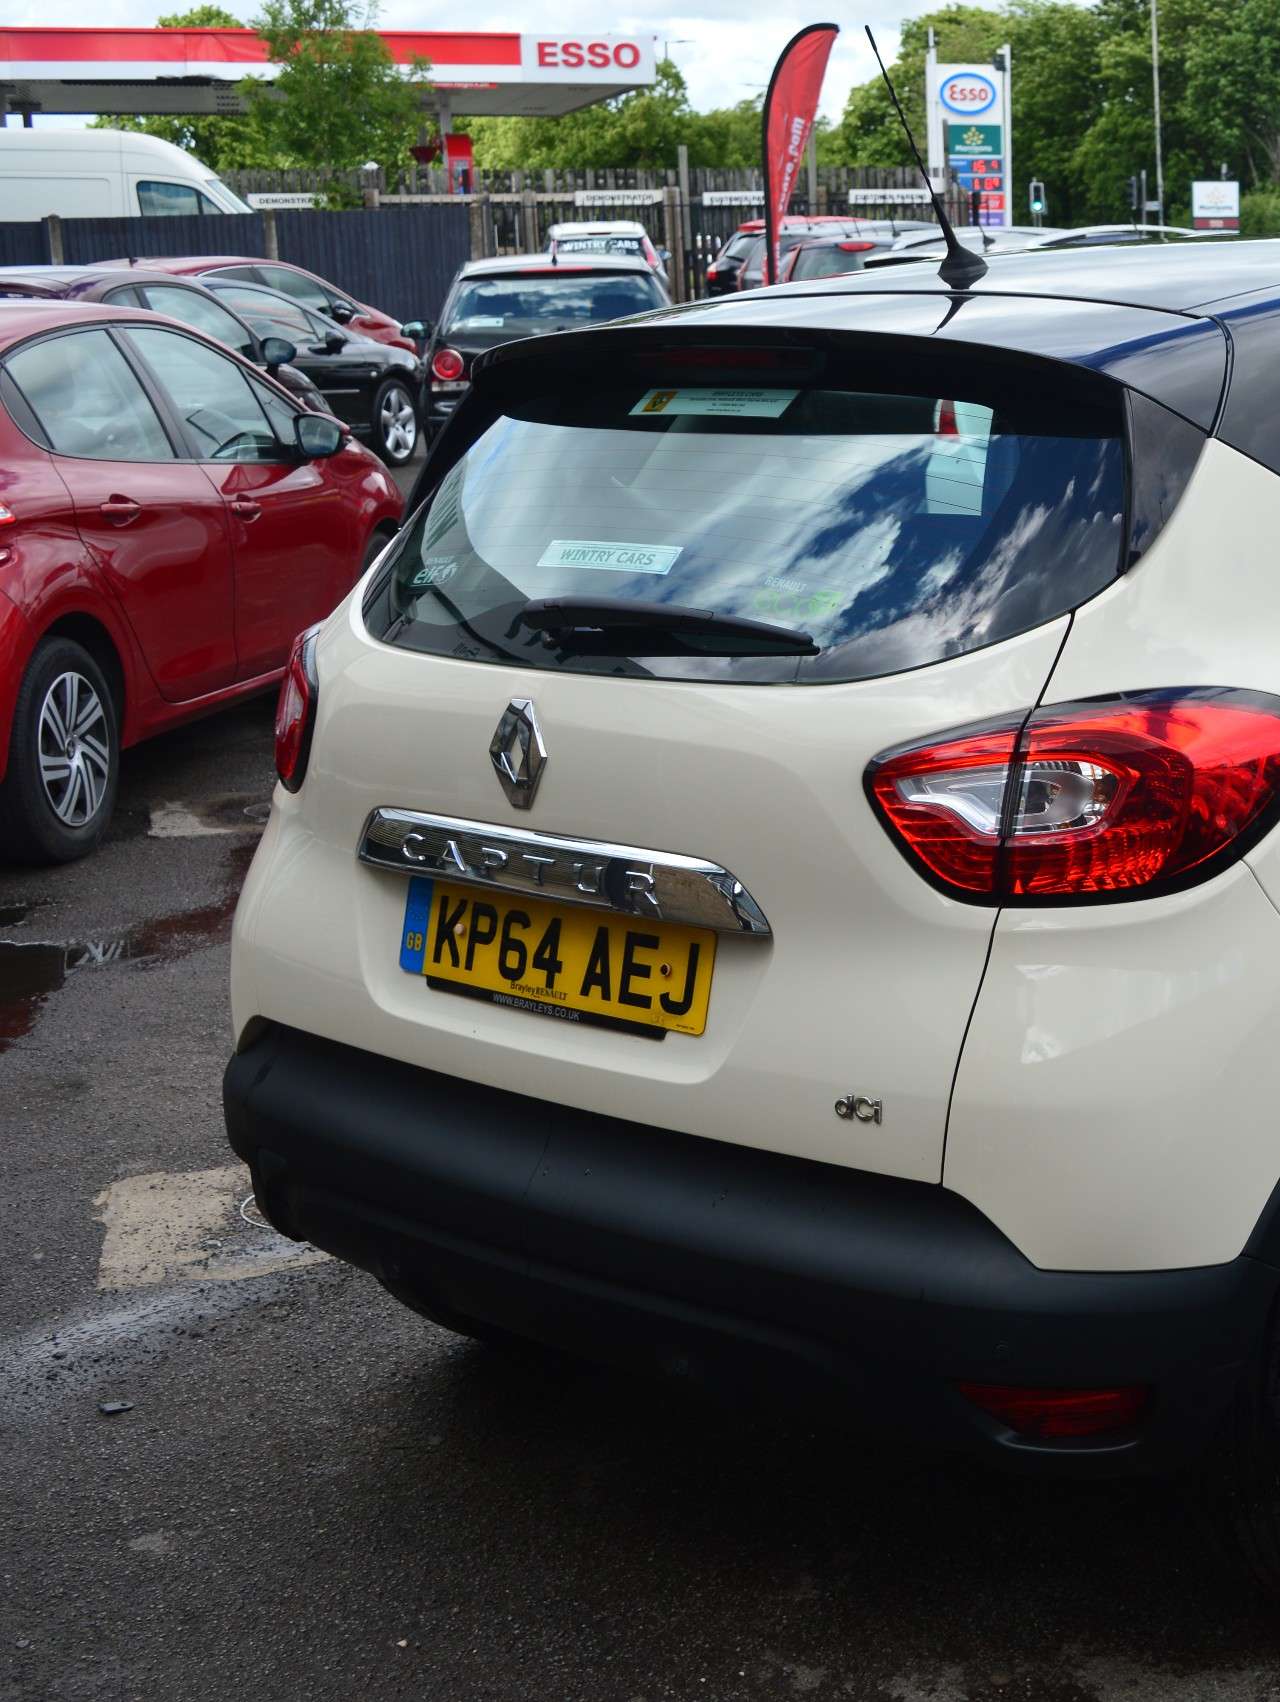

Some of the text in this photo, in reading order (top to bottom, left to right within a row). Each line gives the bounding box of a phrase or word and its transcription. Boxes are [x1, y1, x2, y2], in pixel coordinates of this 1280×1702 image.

[537, 42, 640, 68] ESSO
[949, 84, 988, 101] Esso
[560, 549, 657, 566] WINTRY CARS
[764, 575, 807, 592] RENAULT
[402, 833, 663, 912] CAPTUR
[407, 931, 423, 952] GB
[432, 895, 701, 1017] KP64 AEJ
